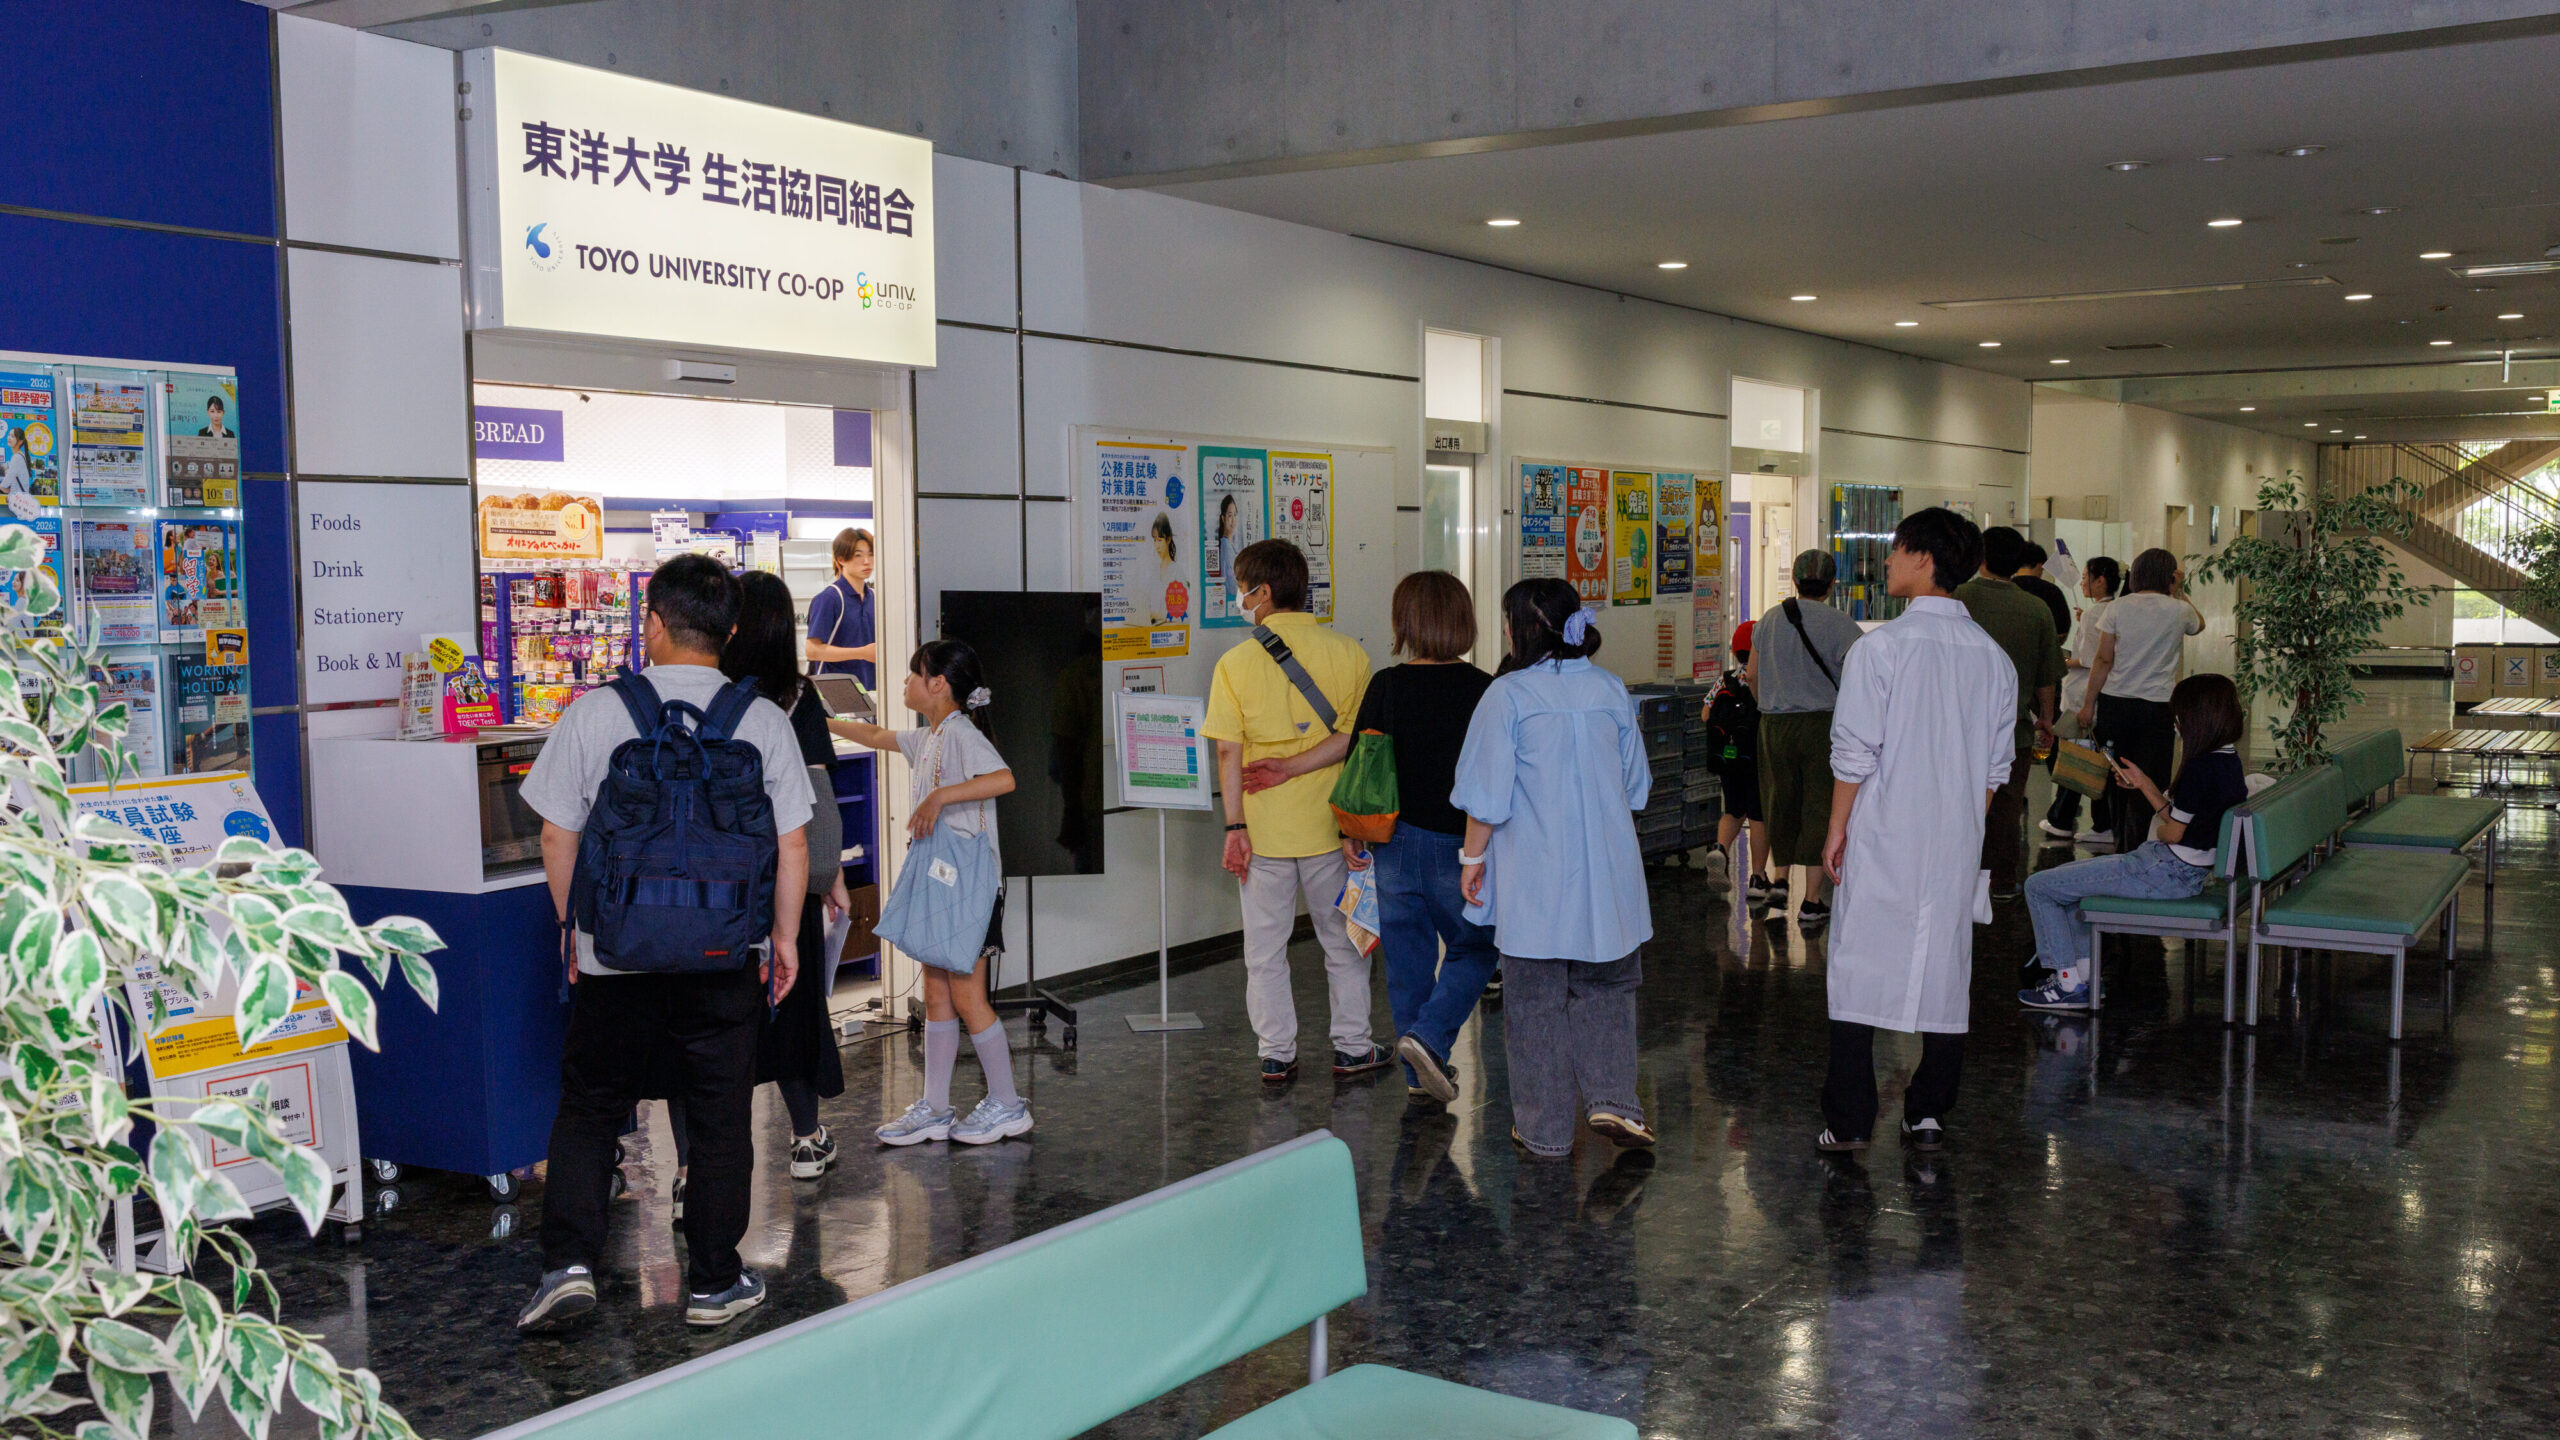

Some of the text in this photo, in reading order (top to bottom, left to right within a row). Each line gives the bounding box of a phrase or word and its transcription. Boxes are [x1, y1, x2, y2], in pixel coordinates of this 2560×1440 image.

[522, 120, 915, 238] 東洋大学 生活協同組合
[575, 244, 844, 301] TOYO UNIVERSITY CO-OP
[877, 299, 913, 311] CO-OP
[9, 390, 50, 405] 語学留学
[475, 421, 545, 444] BREAD
[1434, 435, 1461, 450] 出口専用
[1101, 460, 1158, 480] 公務員試験
[1101, 478, 1148, 497] 対策講座
[1226, 473, 1256, 487] OfferBox
[1282, 472, 1323, 487] キャリアナビ
[310, 513, 361, 531] Foods
[312, 560, 364, 578] Drink
[314, 607, 404, 626] Stationery
[181, 664, 244, 678] WORKING
[316, 653, 360, 672] Book
[366, 652, 381, 670] &
[182, 679, 244, 695] HOLIDAY
[481, 718, 497, 726] Tests
